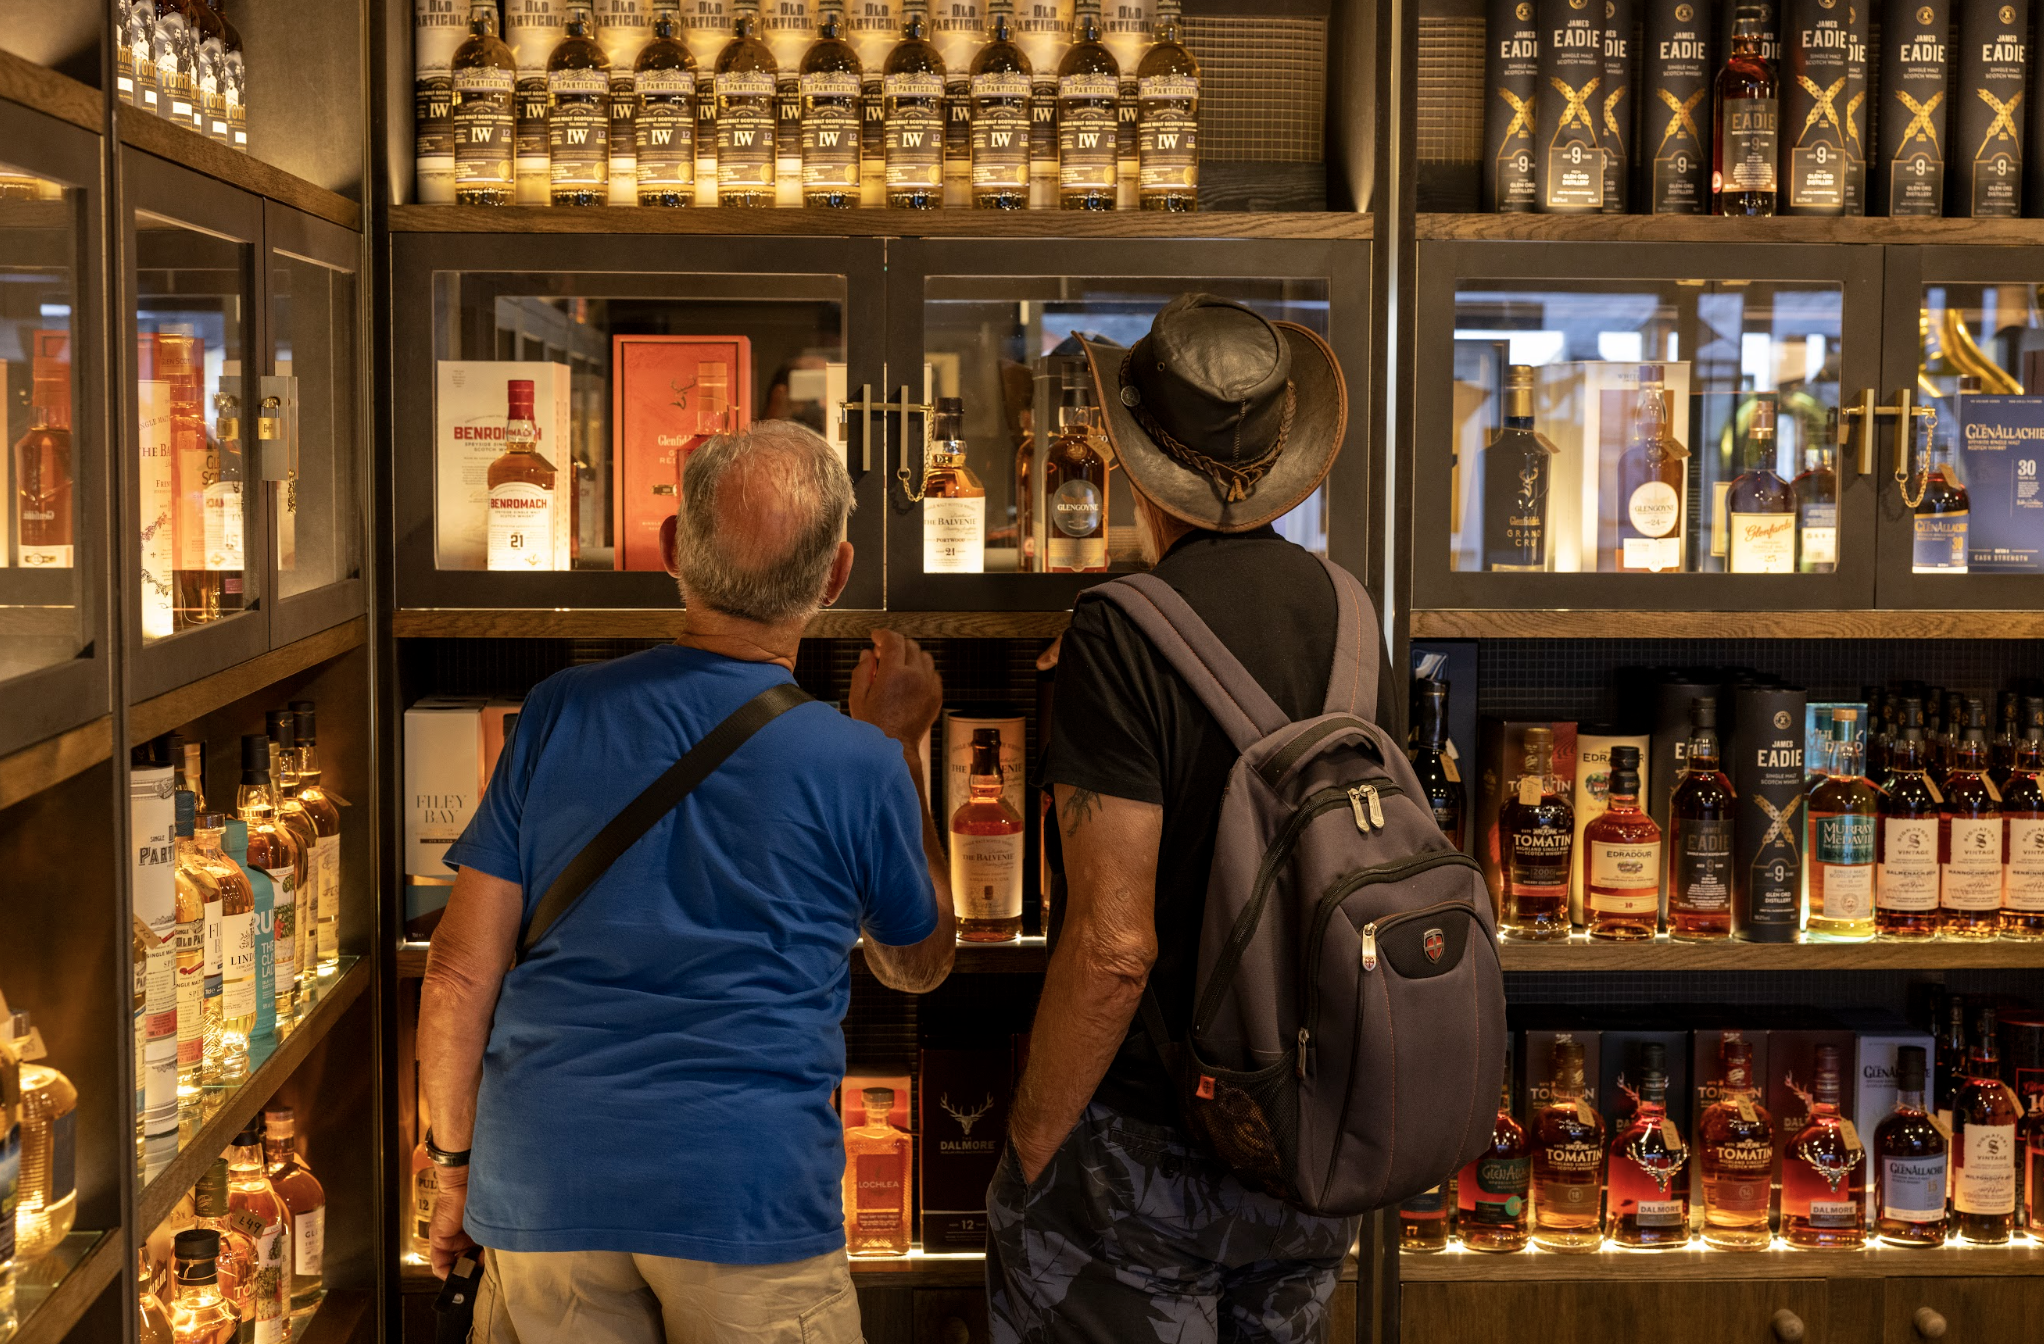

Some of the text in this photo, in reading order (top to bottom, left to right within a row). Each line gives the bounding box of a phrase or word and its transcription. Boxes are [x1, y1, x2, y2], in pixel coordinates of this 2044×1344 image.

[429, 0, 453, 12] OLD
[525, 1, 549, 13] OLD
[612, 1, 635, 13] OLD
[699, 1, 722, 14] OLD
[781, 2, 804, 15] OLD
[865, 3, 888, 17] OLD
[952, 4, 976, 18] OLD
[1033, 5, 1057, 18] OLD
[1118, 6, 1142, 19] OLD
[931, 19, 983, 31] PARTICUL
[1567, 20, 1589, 28] JAMES
[1816, 20, 1838, 28] JAMES
[1514, 31, 1536, 39] JAMES
[1554, 29, 1600, 48] EADIE
[1673, 32, 1695, 40] JAMES
[1802, 30, 1847, 49] EADIE
[1914, 35, 1936, 43] JAMES
[1996, 35, 2017, 43] JAMES
[1501, 40, 1537, 58] EADI
[1604, 39, 1627, 58] DIE
[1660, 41, 1705, 60] EADIE
[1901, 44, 1945, 63] EADIE
[1982, 44, 2025, 63] EADIE
[1732, 113, 1775, 130] EADIE
[1751, 137, 1760, 151] 9
[1571, 146, 1581, 164] 9
[1816, 146, 1826, 164] 9
[1518, 155, 1528, 172] 9
[1677, 156, 1687, 173] 9
[1915, 159, 1925, 176] 9
[1997, 159, 2007, 176] 9
[142, 447, 157, 457] HE
[2018, 459, 2036, 476] 30
[490, 498, 547, 509] BENROMACH
[1057, 503, 1099, 511] GLENGOYNE
[938, 517, 977, 525] BALVENIE
[1506, 529, 1541, 538] GRAND
[511, 534, 523, 548] 21
[1515, 538, 1536, 547] CRU
[1952, 536, 1963, 550] 30
[945, 547, 955, 556] 21
[1974, 554, 2029, 562] CASK STRENGTH
[1772, 740, 1793, 748] JAMES
[1583, 752, 1645, 763] EDRAR
[1757, 749, 1802, 767] EADIE
[951, 764, 967, 774] THE
[416, 795, 467, 809] FILEY
[425, 809, 458, 823] BAY
[1824, 822, 1874, 834] MURRAY
[1513, 834, 1572, 847] TOMATIN
[2022, 827, 2044, 843] SIGNAT
[1688, 834, 1731, 851] EADIE
[138, 845, 175, 866] PARTI
[976, 853, 1015, 861] BALVENIE
[1606, 850, 1652, 858] EDRADOUR
[1706, 859, 1714, 873] 9
[1774, 865, 1784, 882] 9
[231, 953, 255, 966] LIND
[940, 1140, 996, 1150] DALMORE
[1546, 1149, 1602, 1162] TOMATIN
[1716, 1147, 1773, 1160] TOMATIN
[858, 1180, 900, 1189] LOCHLEA
[1927, 1180, 1937, 1192] 15
[418, 1200, 429, 1211] 12
[961, 1220, 974, 1230] 12
